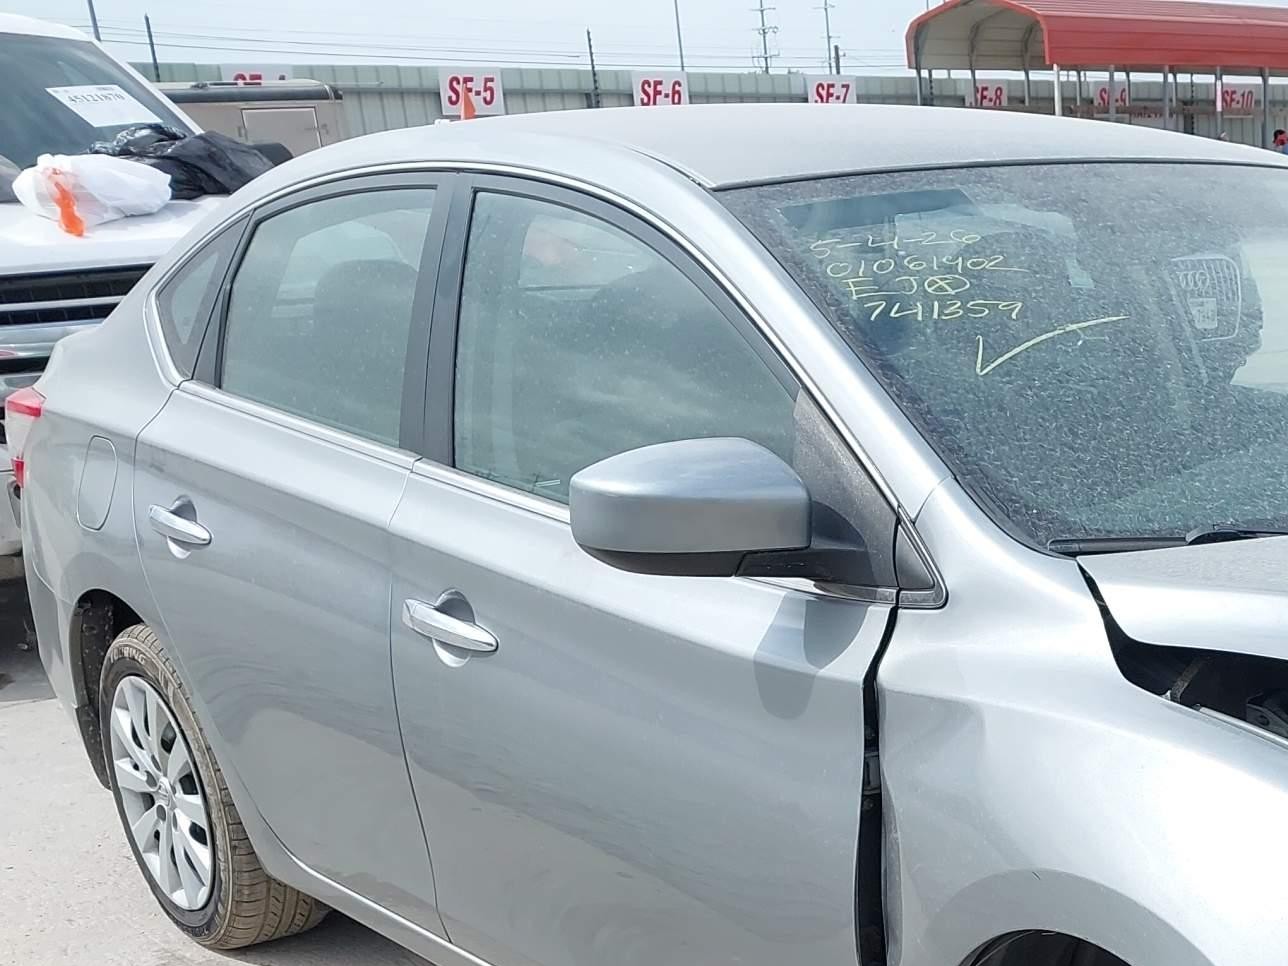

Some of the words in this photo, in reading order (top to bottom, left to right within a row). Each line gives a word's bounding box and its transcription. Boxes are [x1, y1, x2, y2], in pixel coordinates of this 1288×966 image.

[447, 76, 495, 106] SF-5
[640, 79, 682, 106] SF-6
[815, 82, 850, 103] SF-7
[1098, 88, 1126, 107] S-9
[1222, 90, 1254, 109] SF-10
[809, 229, 982, 258] 5-4-26
[864, 300, 1024, 321] 741359
